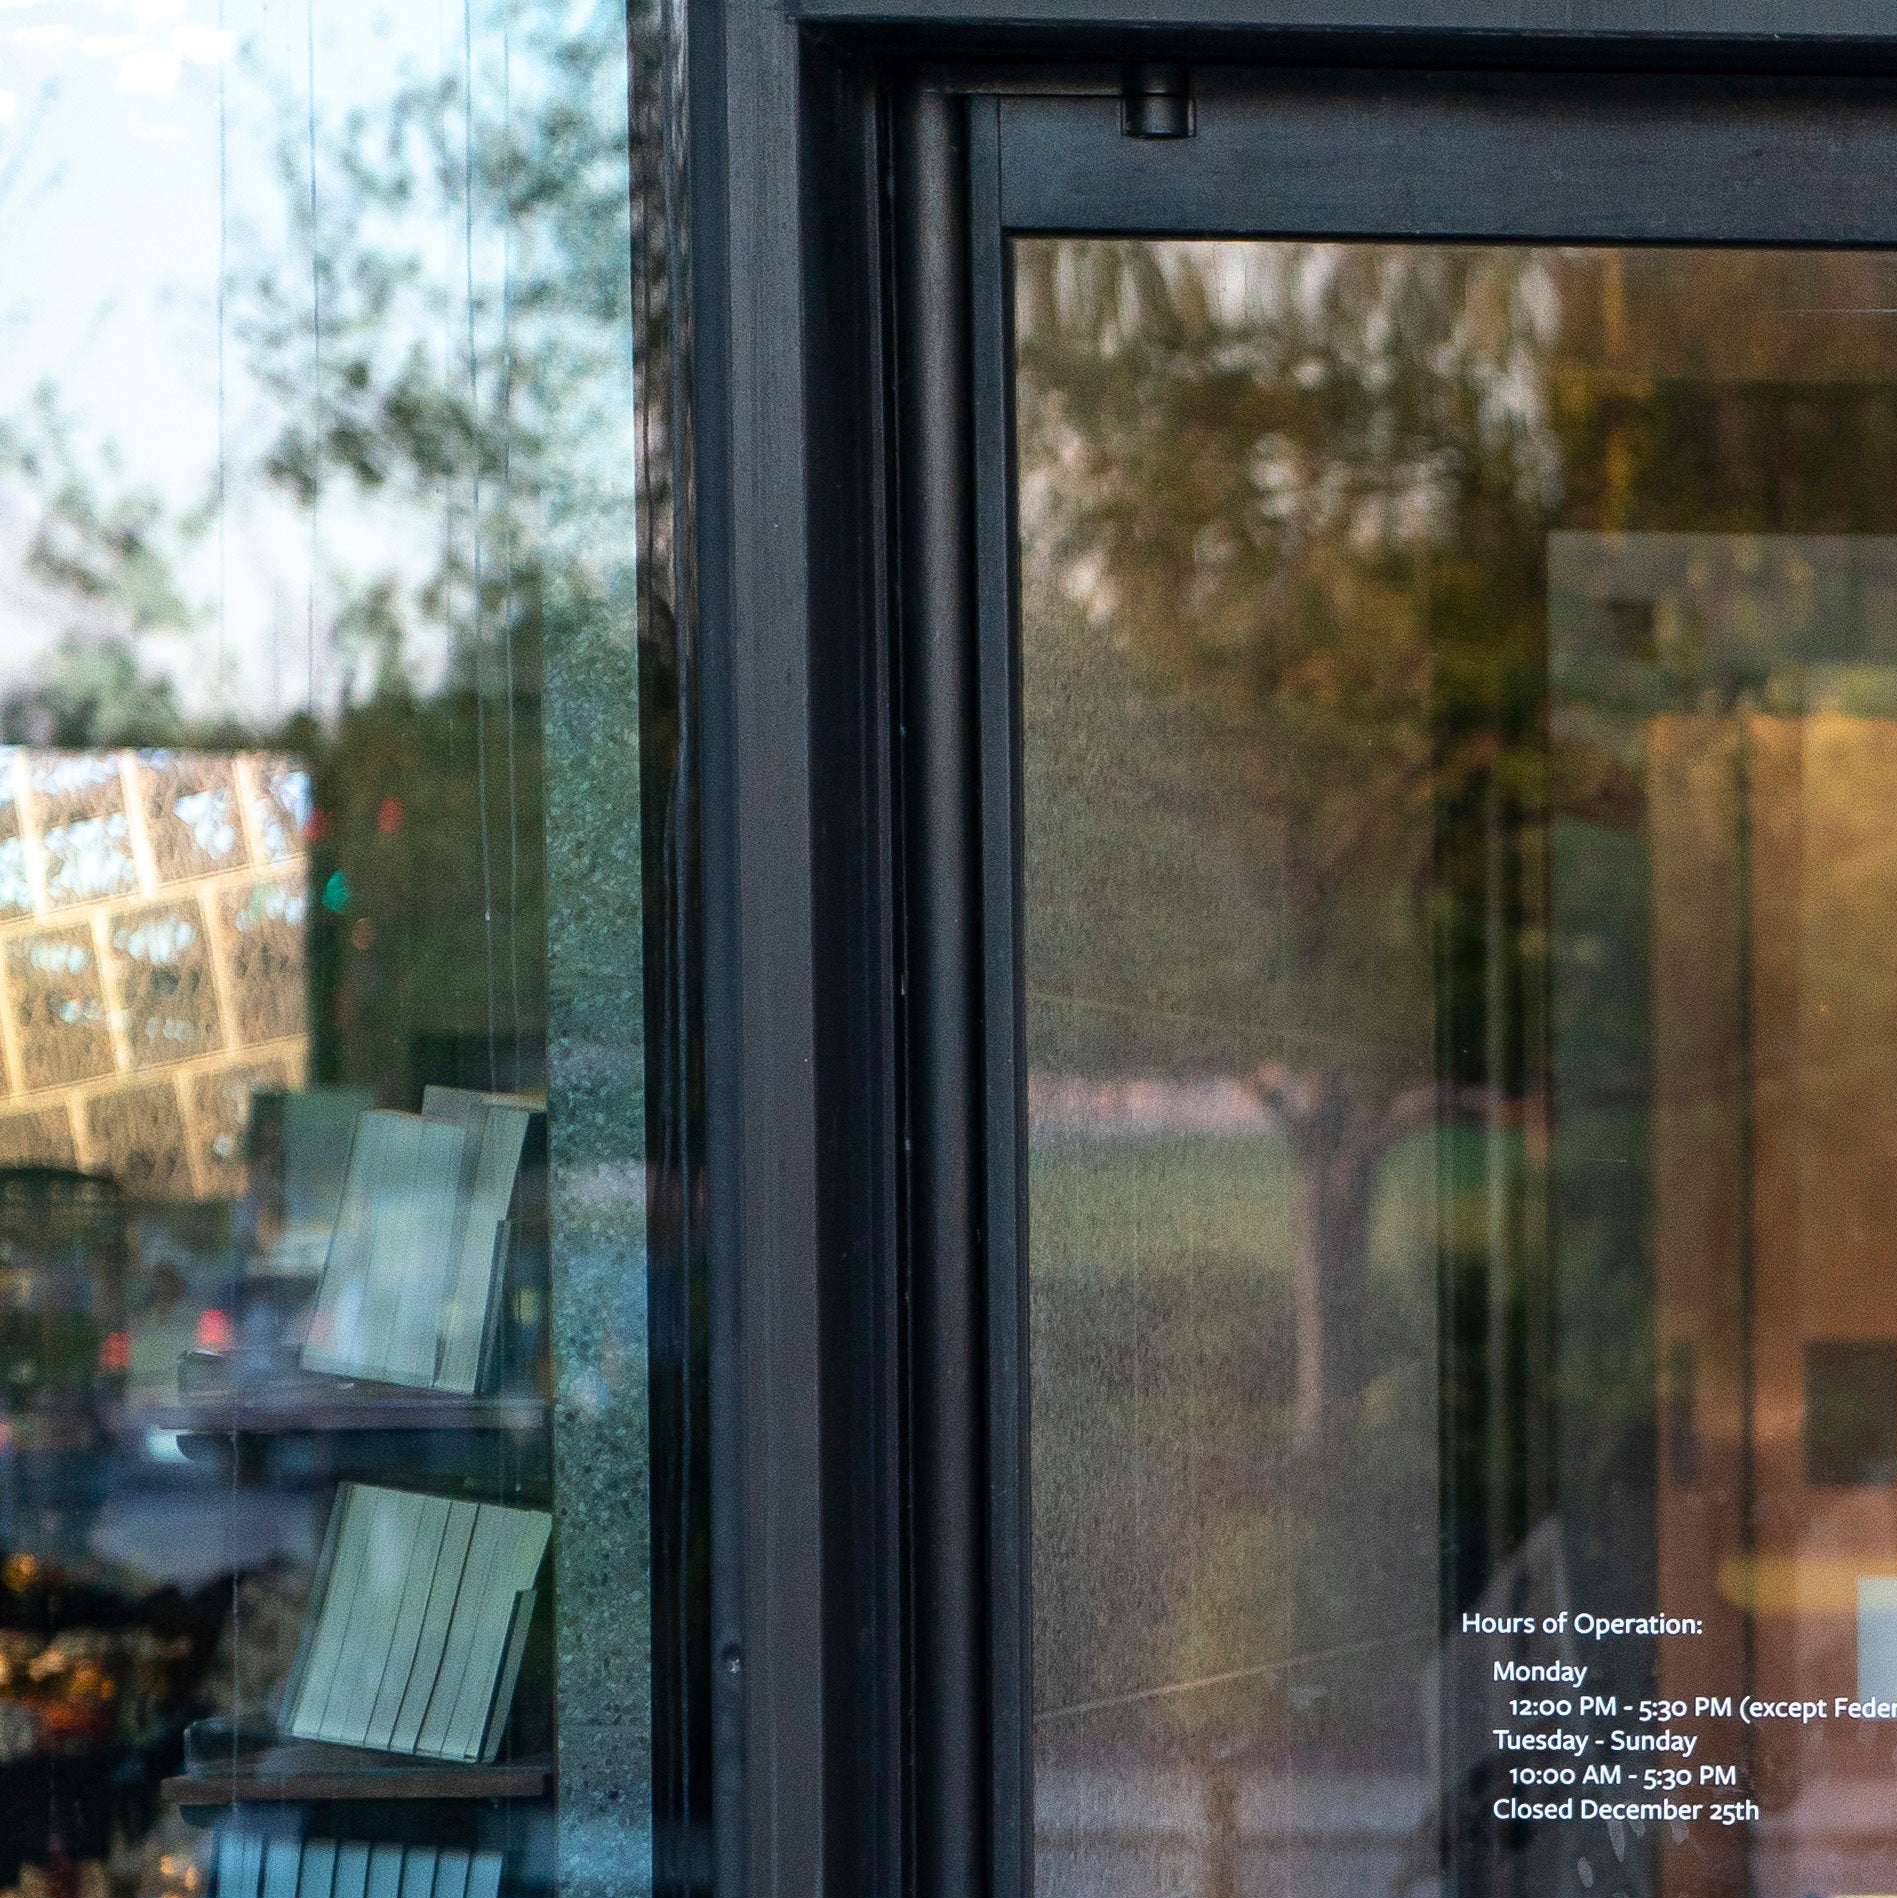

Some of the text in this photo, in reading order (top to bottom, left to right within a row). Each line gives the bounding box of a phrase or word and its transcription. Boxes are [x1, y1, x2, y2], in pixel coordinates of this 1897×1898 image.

[1461, 1611, 1703, 1641] Hours of Operation:
[1493, 1659, 1588, 1688] Monday
[1508, 1699, 1573, 1717] 12:00
[1579, 1696, 1617, 1717] PM
[1638, 1700, 1688, 1723] 5:30
[1694, 1696, 1732, 1718] PM
[1739, 1695, 1828, 1726] (except
[1492, 1728, 1590, 1757] Tuesday
[1610, 1728, 1698, 1757] Sunday
[1509, 1767, 1576, 1785] 10:00
[1581, 1764, 1622, 1785] AM
[1642, 1768, 1693, 1791] 5:30
[1699, 1764, 1737, 1786] PM
[1493, 1797, 1760, 1826] Closed December 25th
